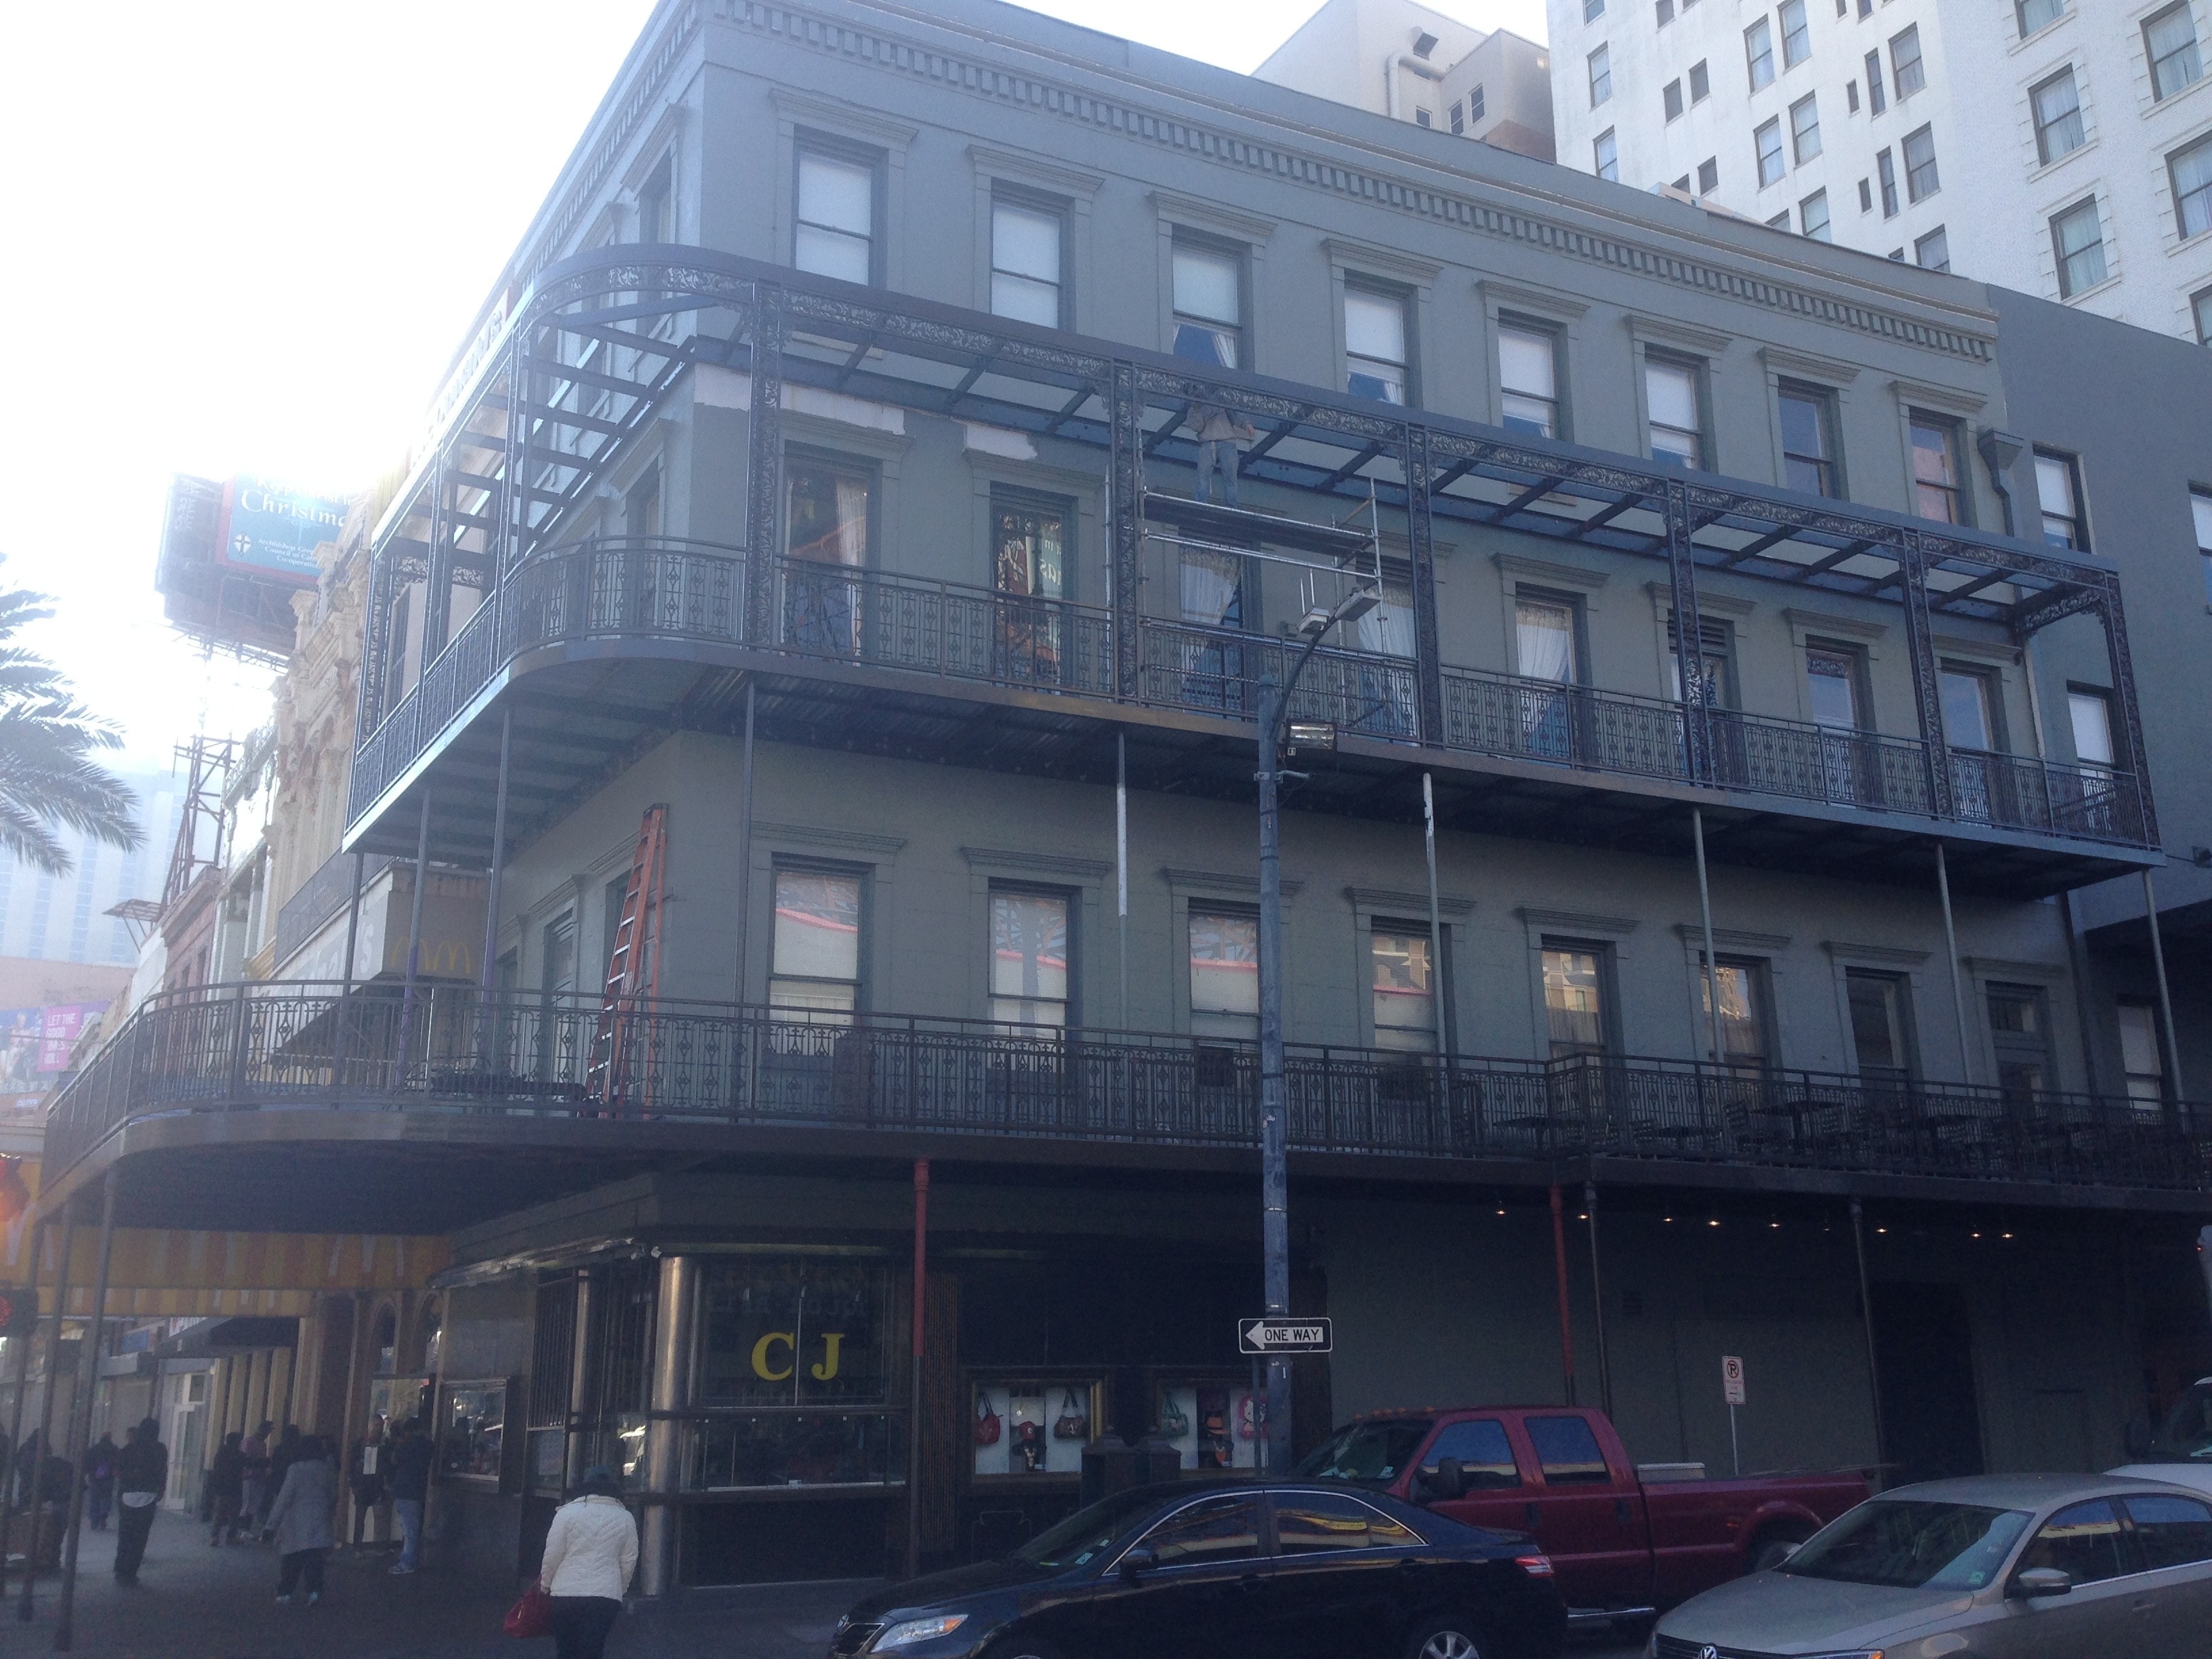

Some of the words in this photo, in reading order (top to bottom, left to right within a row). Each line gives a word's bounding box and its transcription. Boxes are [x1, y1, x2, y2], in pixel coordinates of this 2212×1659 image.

[241, 489, 346, 528] Christma
[265, 546, 291, 556] Council
[277, 556, 316, 569] Co-operativ
[47, 1014, 60, 1026] LET
[62, 1012, 76, 1025] THE
[1265, 1329, 1288, 1341] ONE
[1293, 1328, 1319, 1341] WAY
